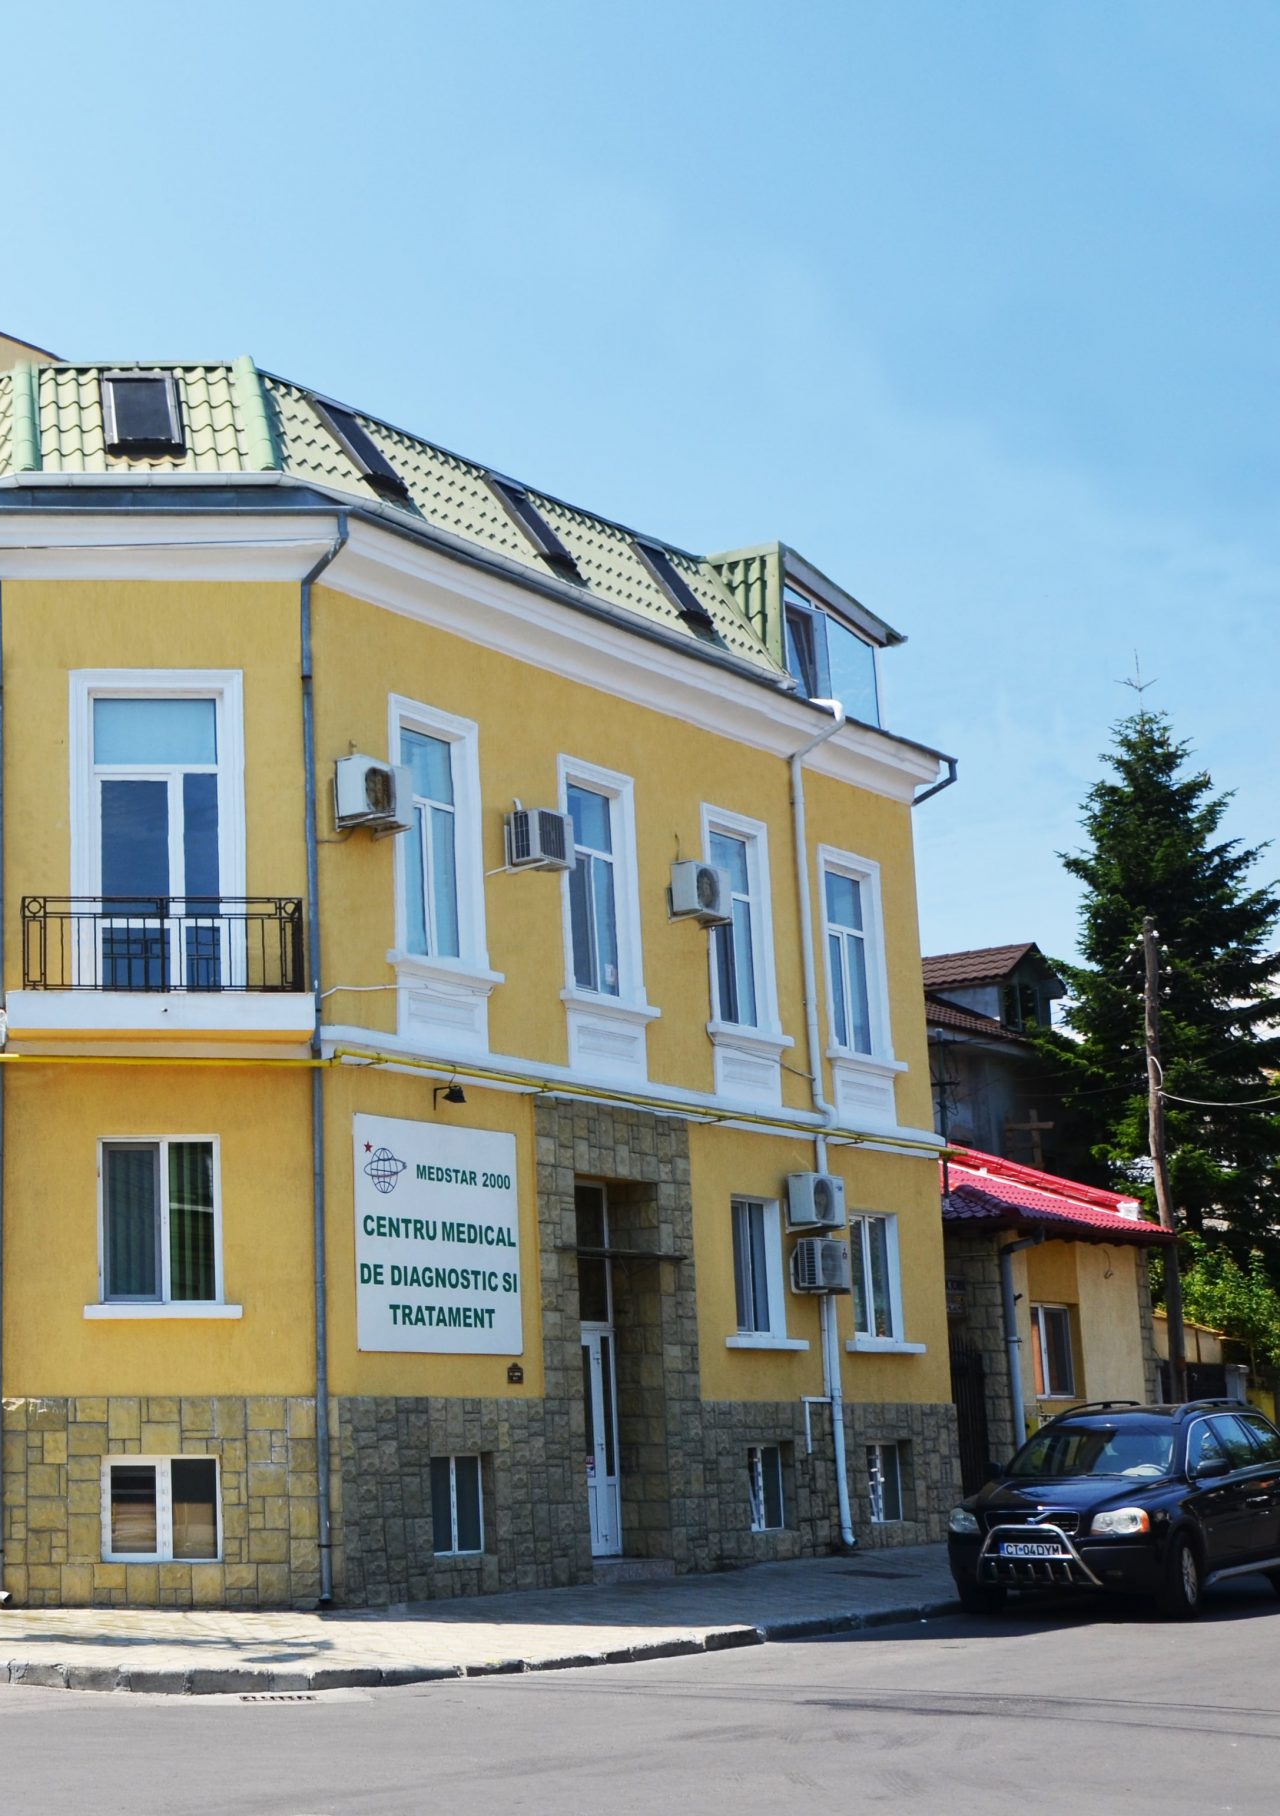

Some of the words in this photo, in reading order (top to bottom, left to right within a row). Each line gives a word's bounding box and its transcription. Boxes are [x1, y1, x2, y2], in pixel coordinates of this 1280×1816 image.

[416, 1164, 478, 1186] MEDSTAR
[482, 1172, 511, 1190] 2000
[363, 1214, 437, 1241] CENTRU
[441, 1220, 516, 1247] MEDICAL
[360, 1263, 384, 1285] DE
[390, 1265, 499, 1292] DIAGNOSTIC
[502, 1272, 518, 1293] SI
[389, 1304, 495, 1329] TRATAMENT
